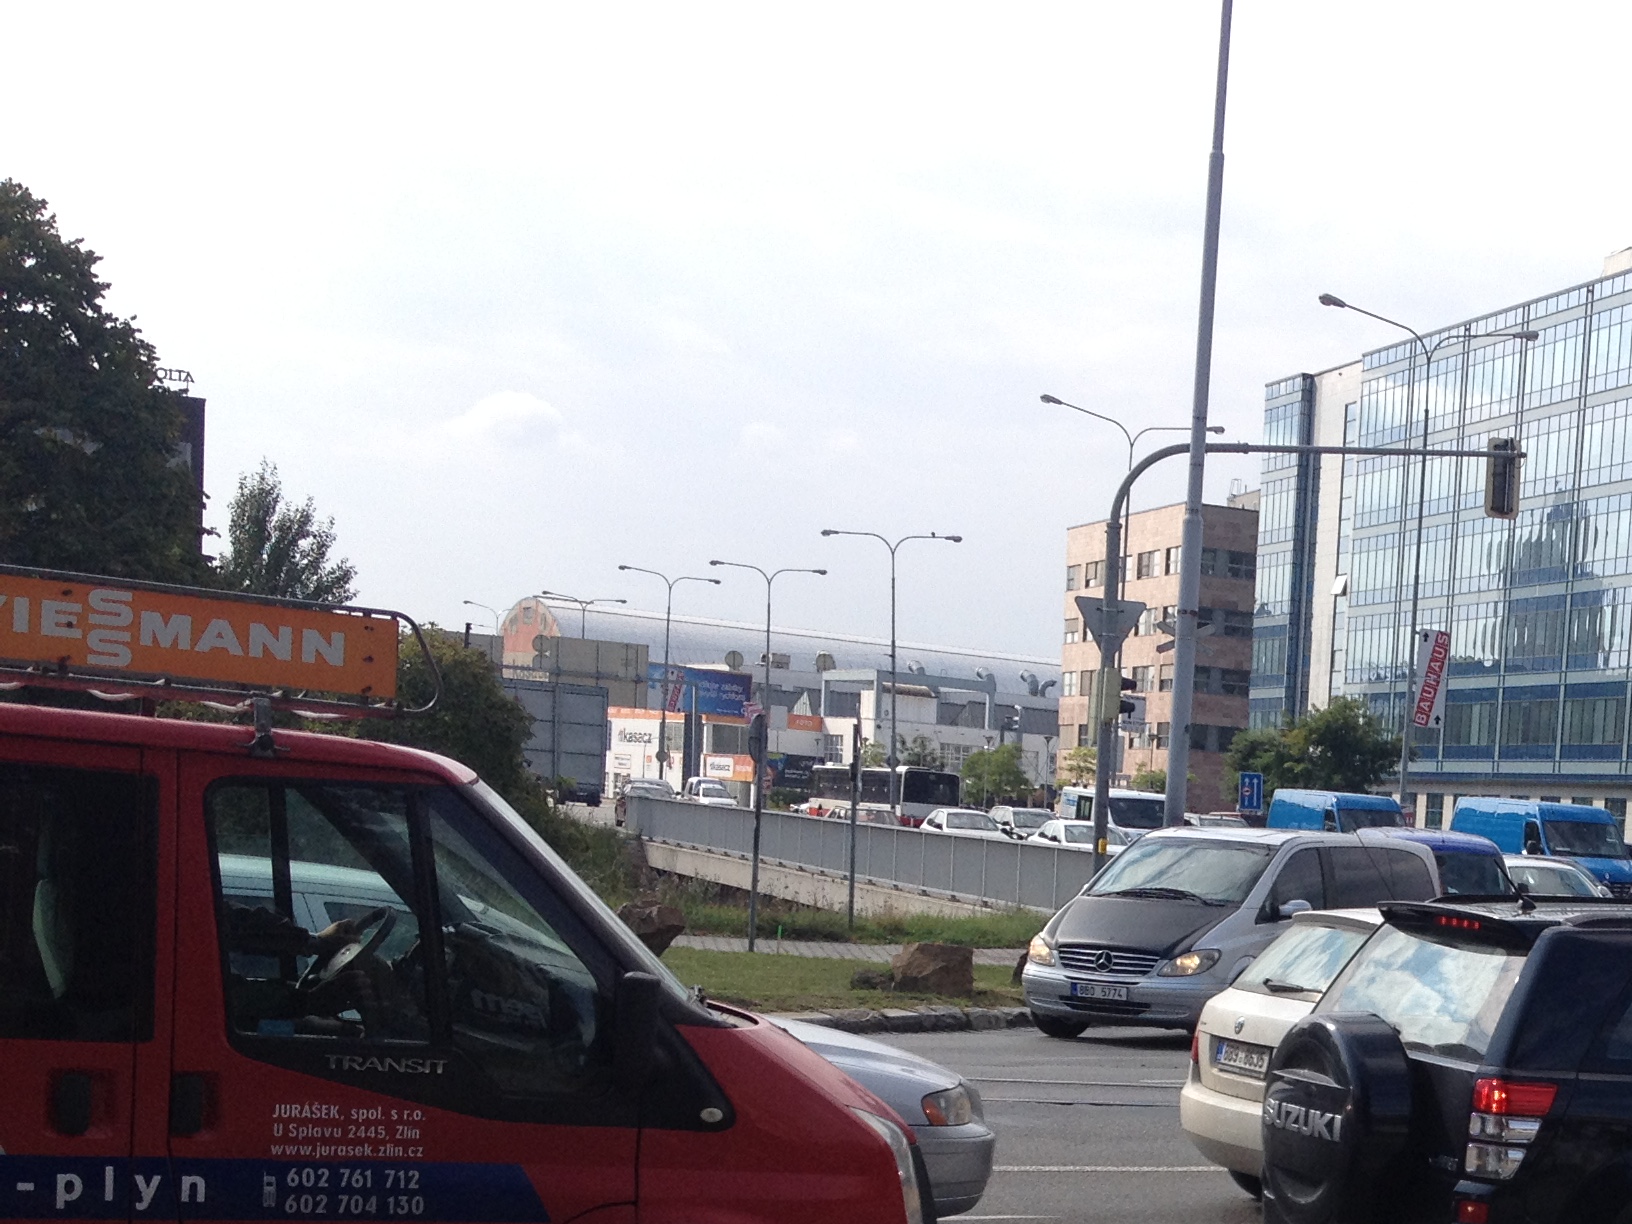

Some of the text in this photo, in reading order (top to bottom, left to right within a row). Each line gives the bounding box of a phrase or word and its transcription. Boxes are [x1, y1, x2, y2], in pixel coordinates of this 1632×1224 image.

[154, 366, 195, 384] OLTA
[0, 588, 345, 667] IESSMANN
[1414, 632, 1450, 726] BAUHAUS
[325, 1054, 448, 1075] TRANSIT
[272, 1101, 426, 1122] JURÁŠEK, spol. s r.o.
[1263, 1097, 1342, 1143] SUZUKI
[273, 1123, 283, 1138] U
[289, 1124, 342, 1140] Splavu
[348, 1126, 389, 1141] 2445,
[271, 1143, 424, 1159] www.jurasek.zlin.cz
[286, 1167, 420, 1189] 602 761 712
[285, 1194, 425, 1216] 602 704 130
